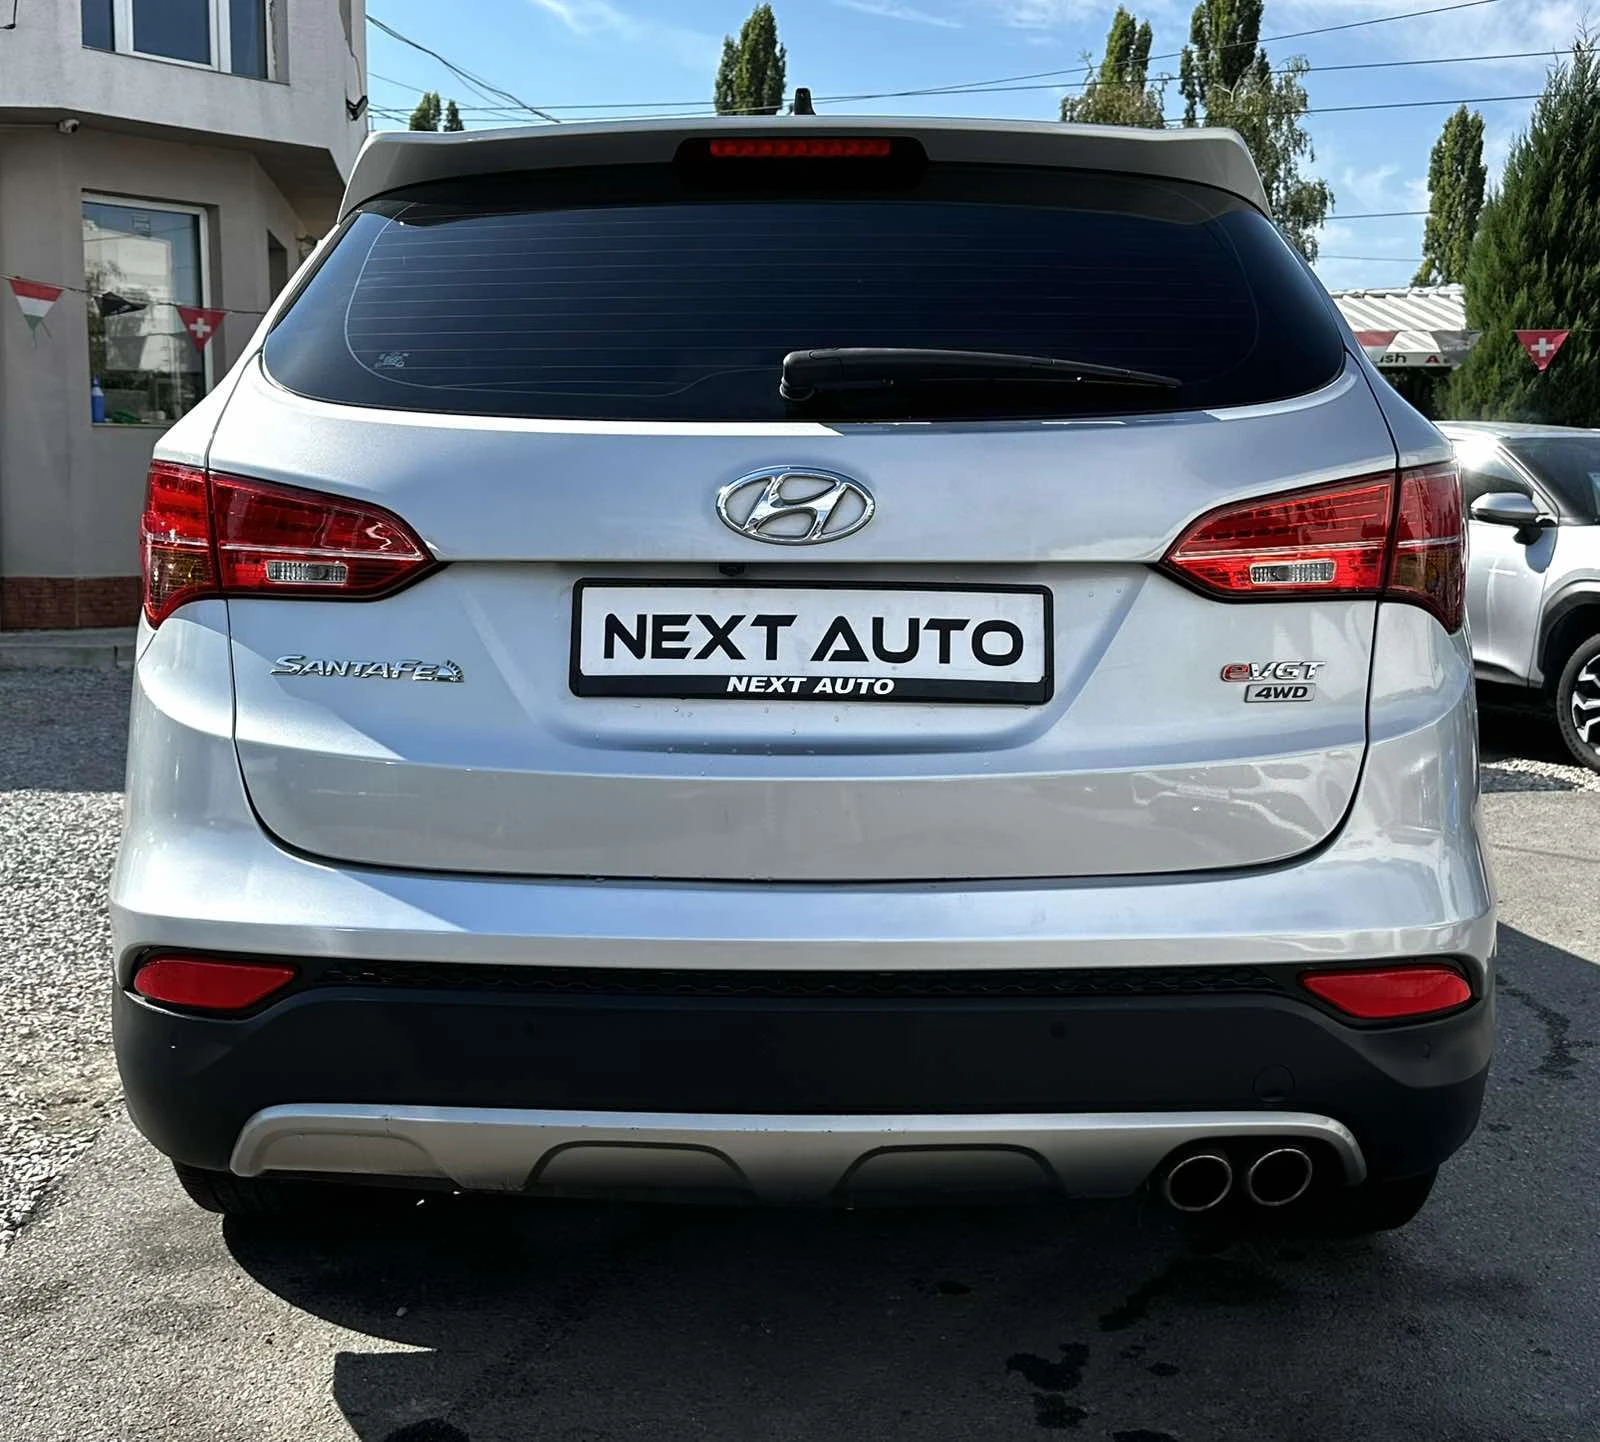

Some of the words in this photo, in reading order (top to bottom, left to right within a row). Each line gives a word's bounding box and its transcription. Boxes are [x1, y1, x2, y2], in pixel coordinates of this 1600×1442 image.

[603, 612, 798, 661] NEXT
[810, 615, 1024, 667] AUTO
[726, 676, 807, 693] NEXT
[812, 677, 896, 695] AUTO
[1254, 686, 1308, 699] 4WD
